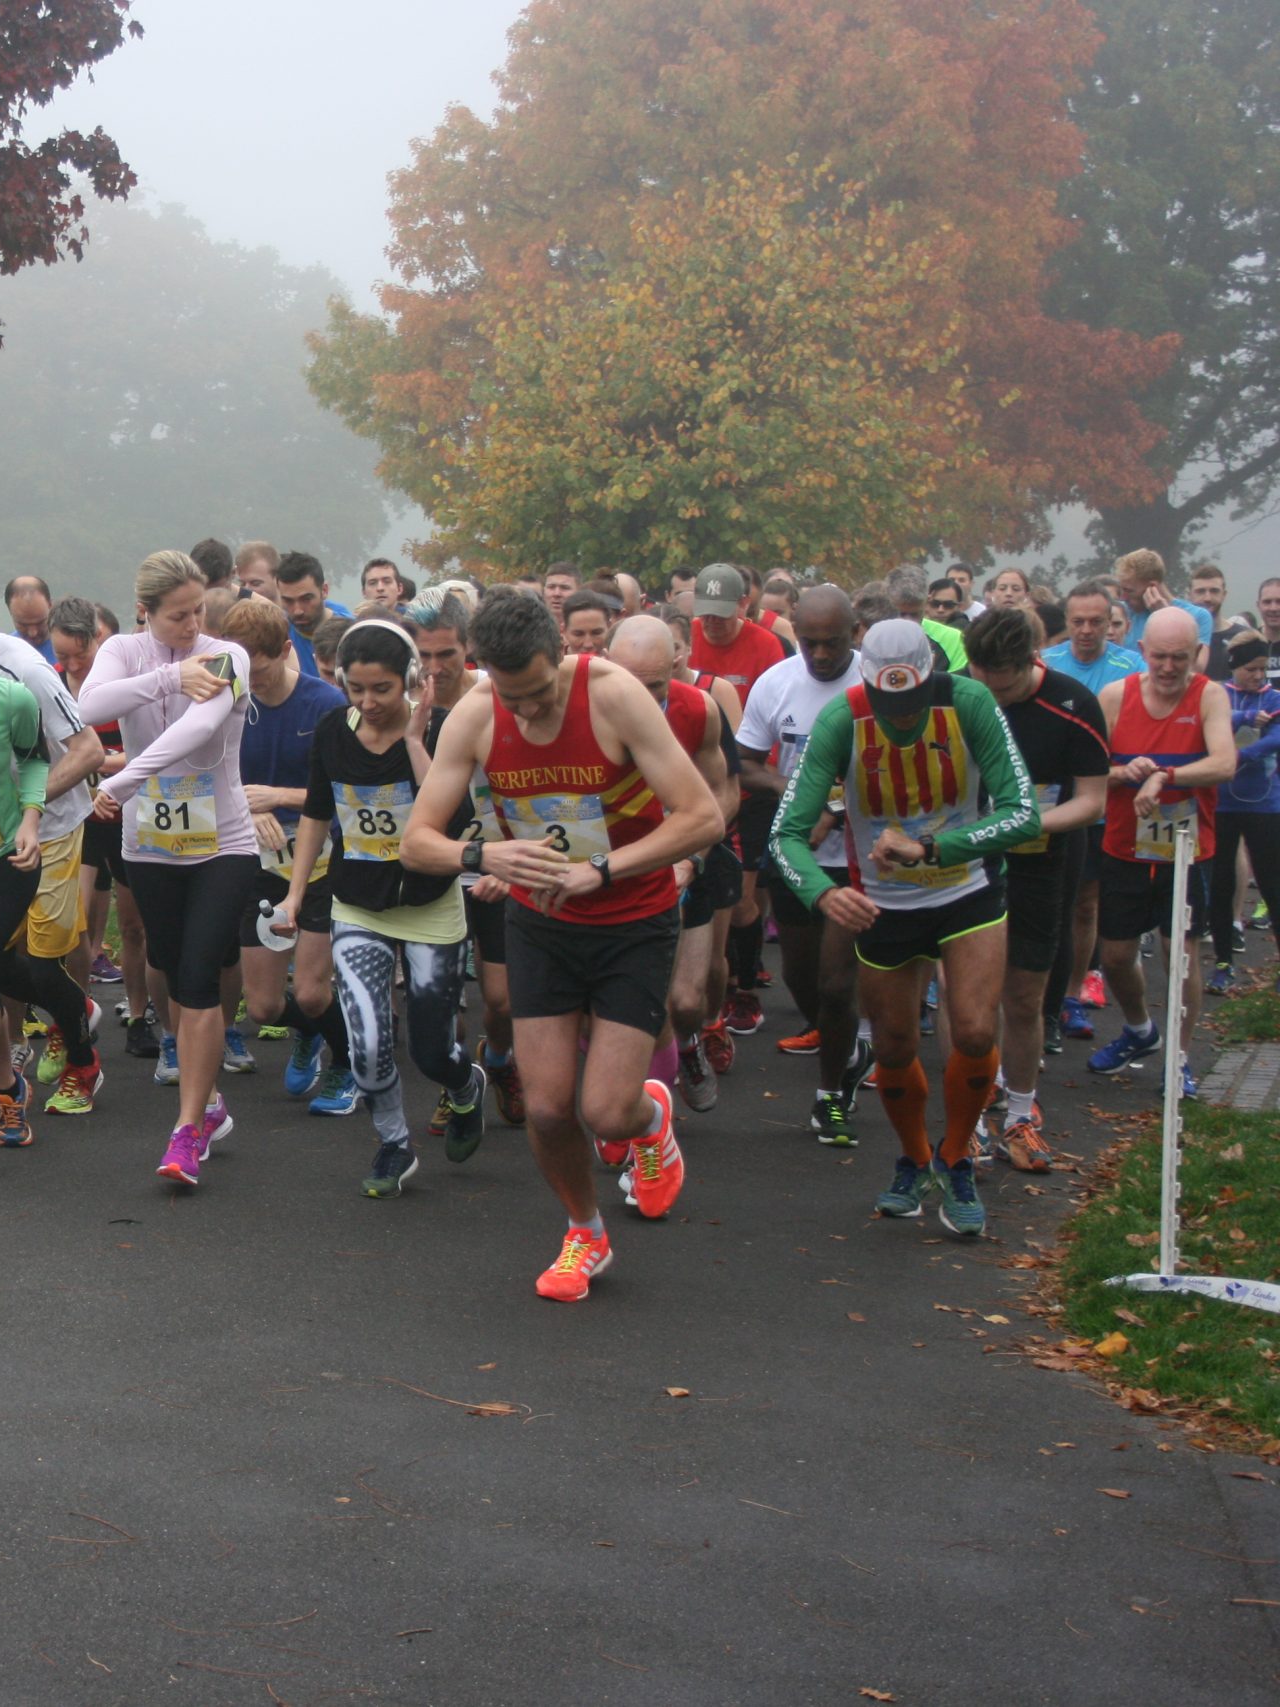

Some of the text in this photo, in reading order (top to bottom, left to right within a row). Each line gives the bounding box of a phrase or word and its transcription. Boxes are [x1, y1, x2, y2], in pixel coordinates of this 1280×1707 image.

[487, 765, 607, 790] SERPENTINE
[154, 802, 190, 831] 81
[357, 808, 397, 836] 83
[545, 824, 570, 853] 3
